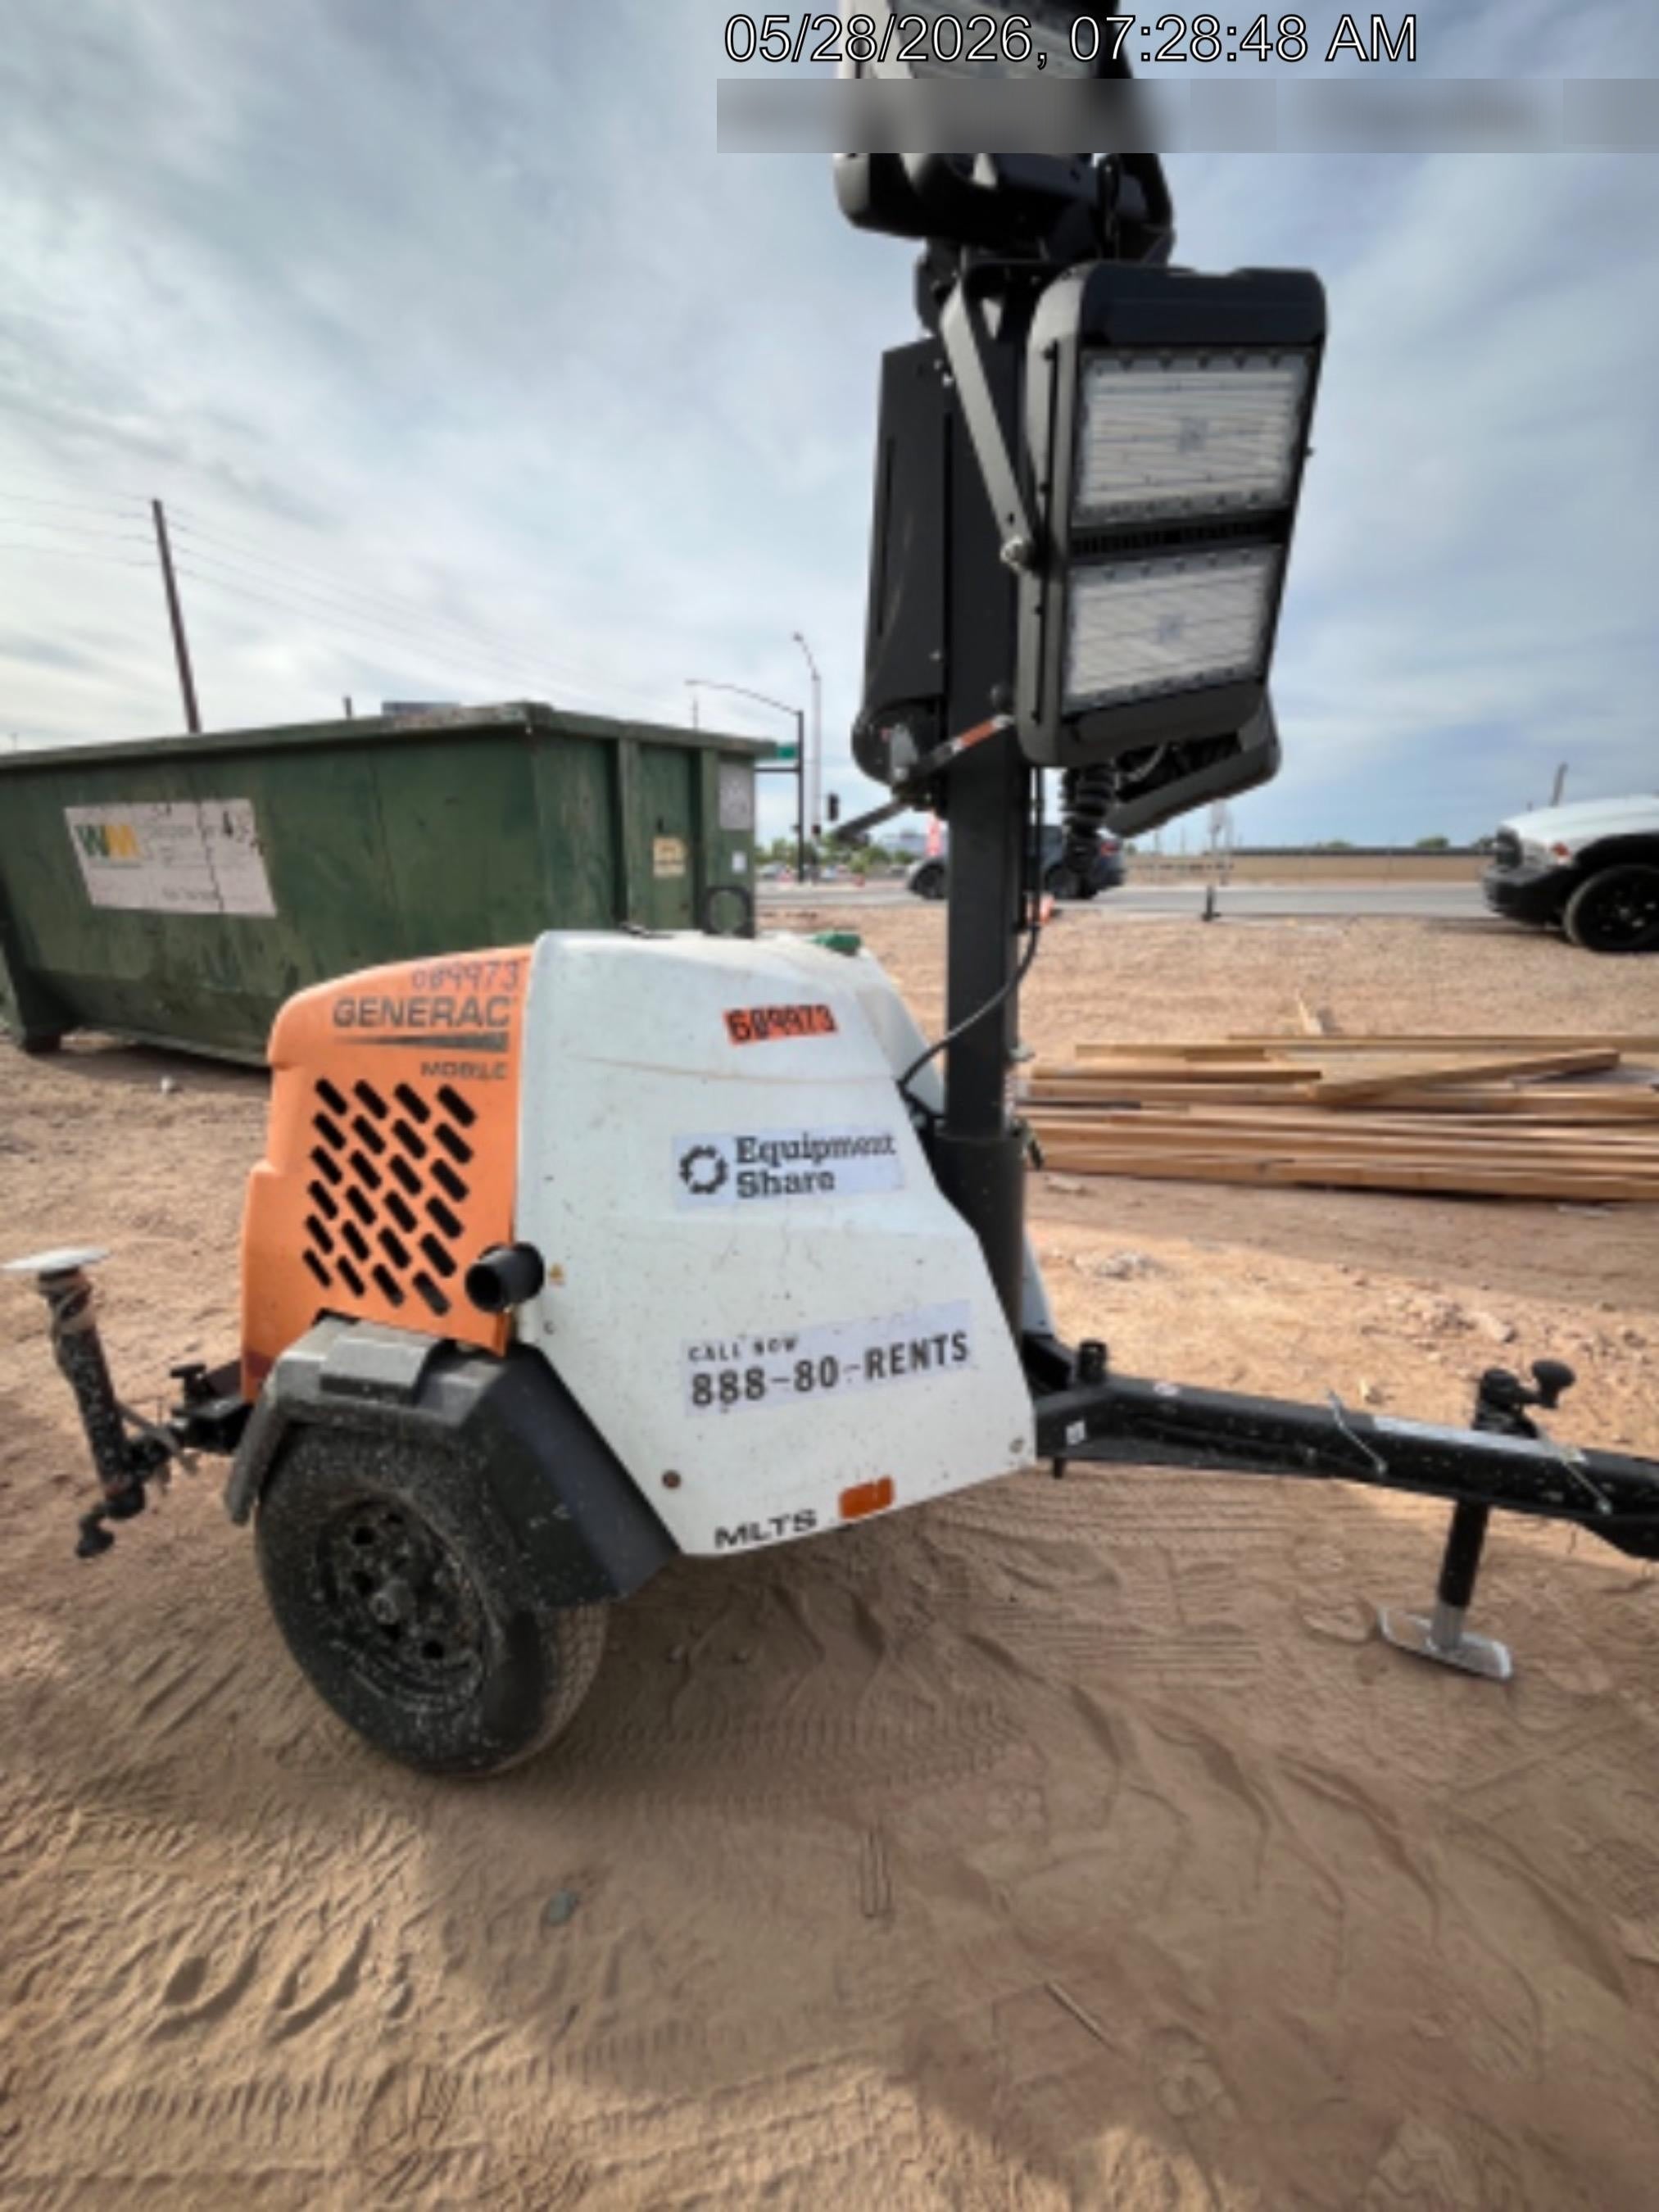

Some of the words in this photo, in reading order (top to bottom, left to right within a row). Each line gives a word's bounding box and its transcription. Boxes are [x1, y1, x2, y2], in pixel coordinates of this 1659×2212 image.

[333, 995, 510, 1028] GENERAC
[734, 1130, 896, 1168] Equipment
[736, 1168, 836, 1200] Share
[687, 1341, 741, 1362] CALL
[751, 1335, 800, 1357] NOW
[691, 1330, 970, 1408] 888-80-RENTS
[714, 1508, 818, 1549] MLTS
